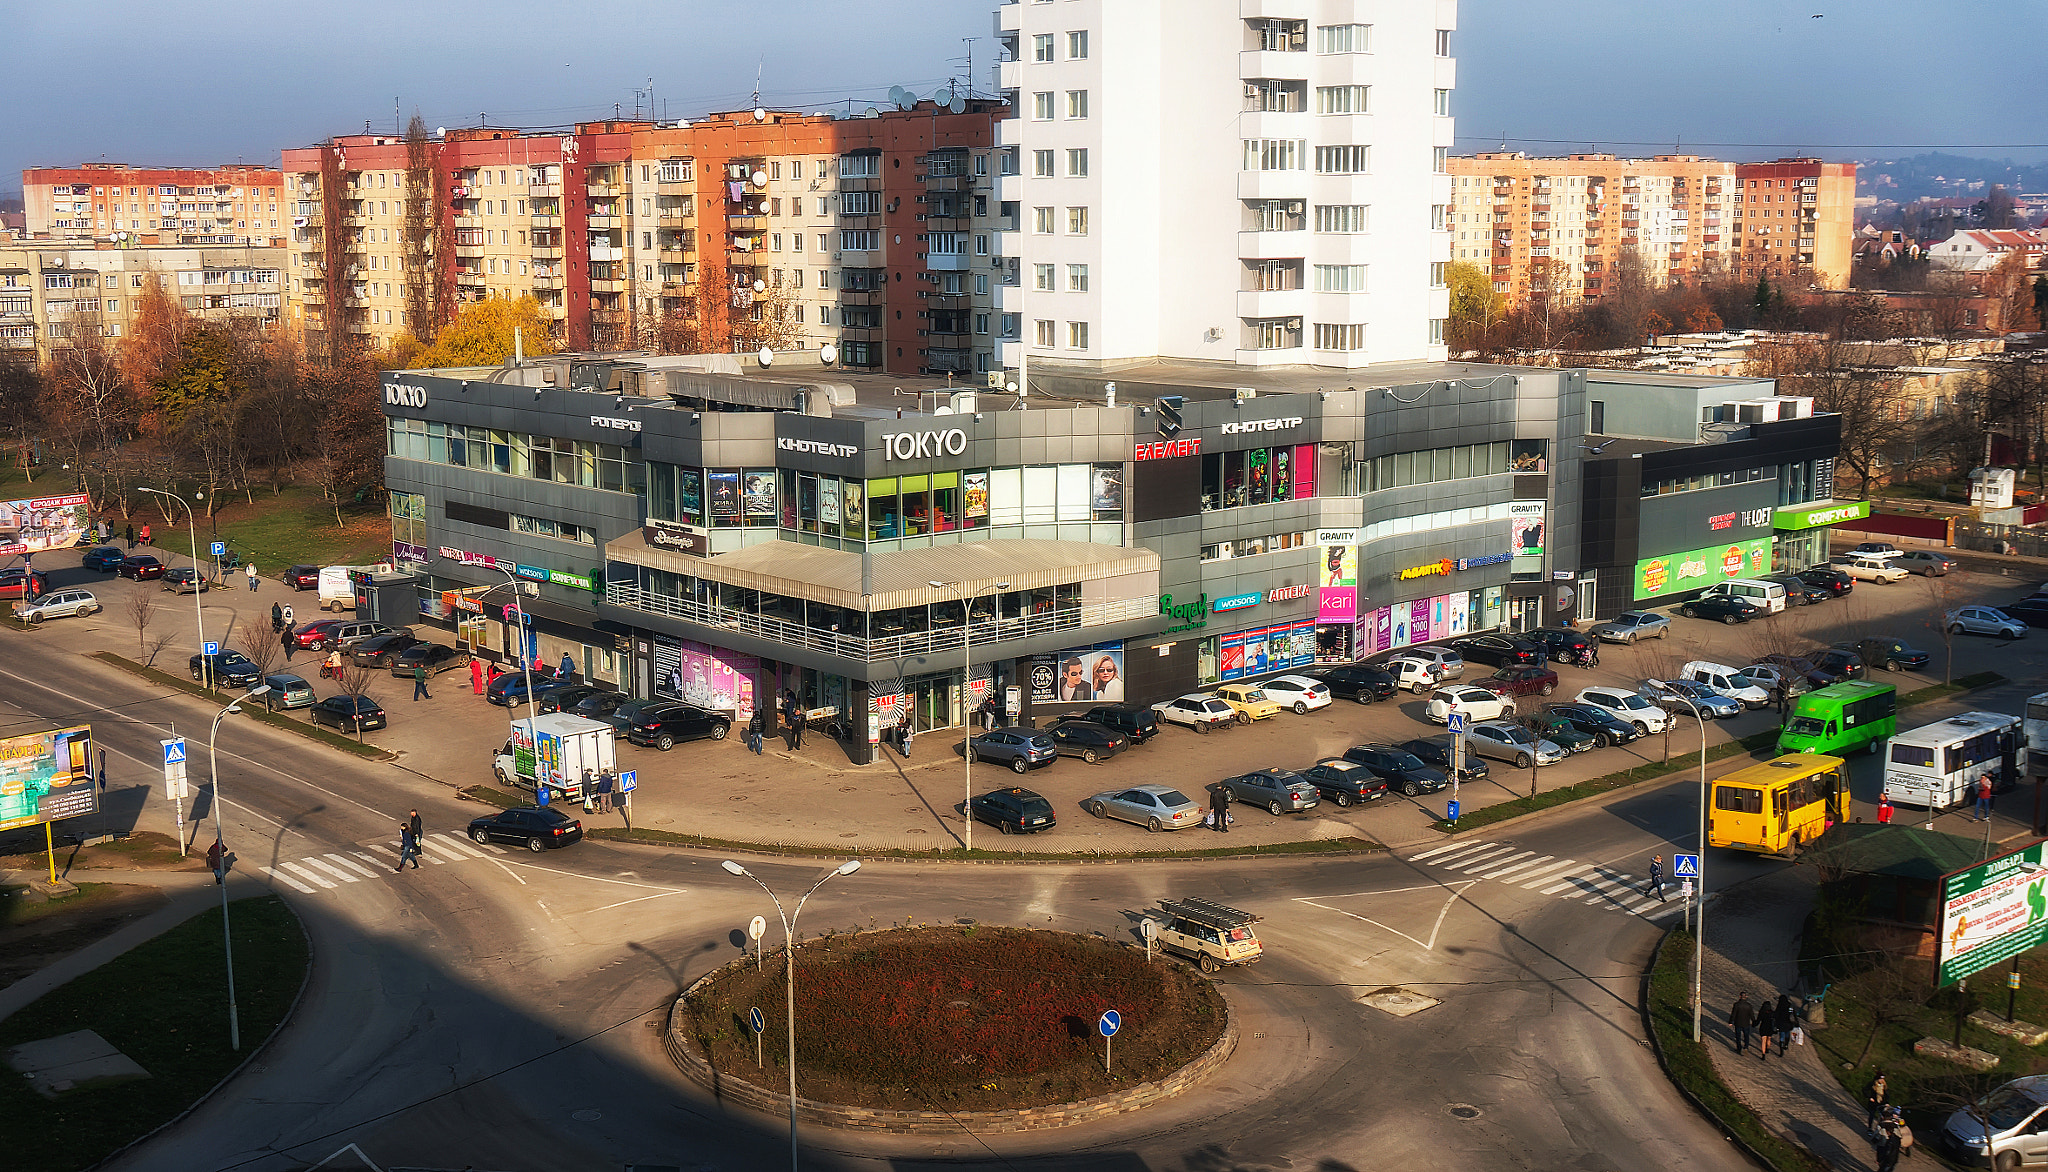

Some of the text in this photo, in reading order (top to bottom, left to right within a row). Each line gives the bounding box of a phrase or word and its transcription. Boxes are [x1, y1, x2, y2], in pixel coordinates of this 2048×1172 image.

[384, 383, 427, 408] TOKYO
[1221, 416, 1303, 435] КІНОТЕАТР
[777, 437, 858, 458] КІНОТЕАТР
[881, 428, 967, 462] TOKYO
[1511, 505, 1542, 513] GRAVITY
[1741, 511, 1752, 526] THE
[1752, 507, 1772, 526] LOFT
[1320, 532, 1354, 541] GRAVITY
[519, 568, 544, 579] watsons
[1268, 584, 1310, 603] АПТЕКА
[1321, 592, 1352, 609] kari
[1221, 596, 1255, 609] watsons
[1413, 622, 1428, 633] 1000
[970, 680, 986, 689] SALE
[876, 694, 897, 707] SALE
